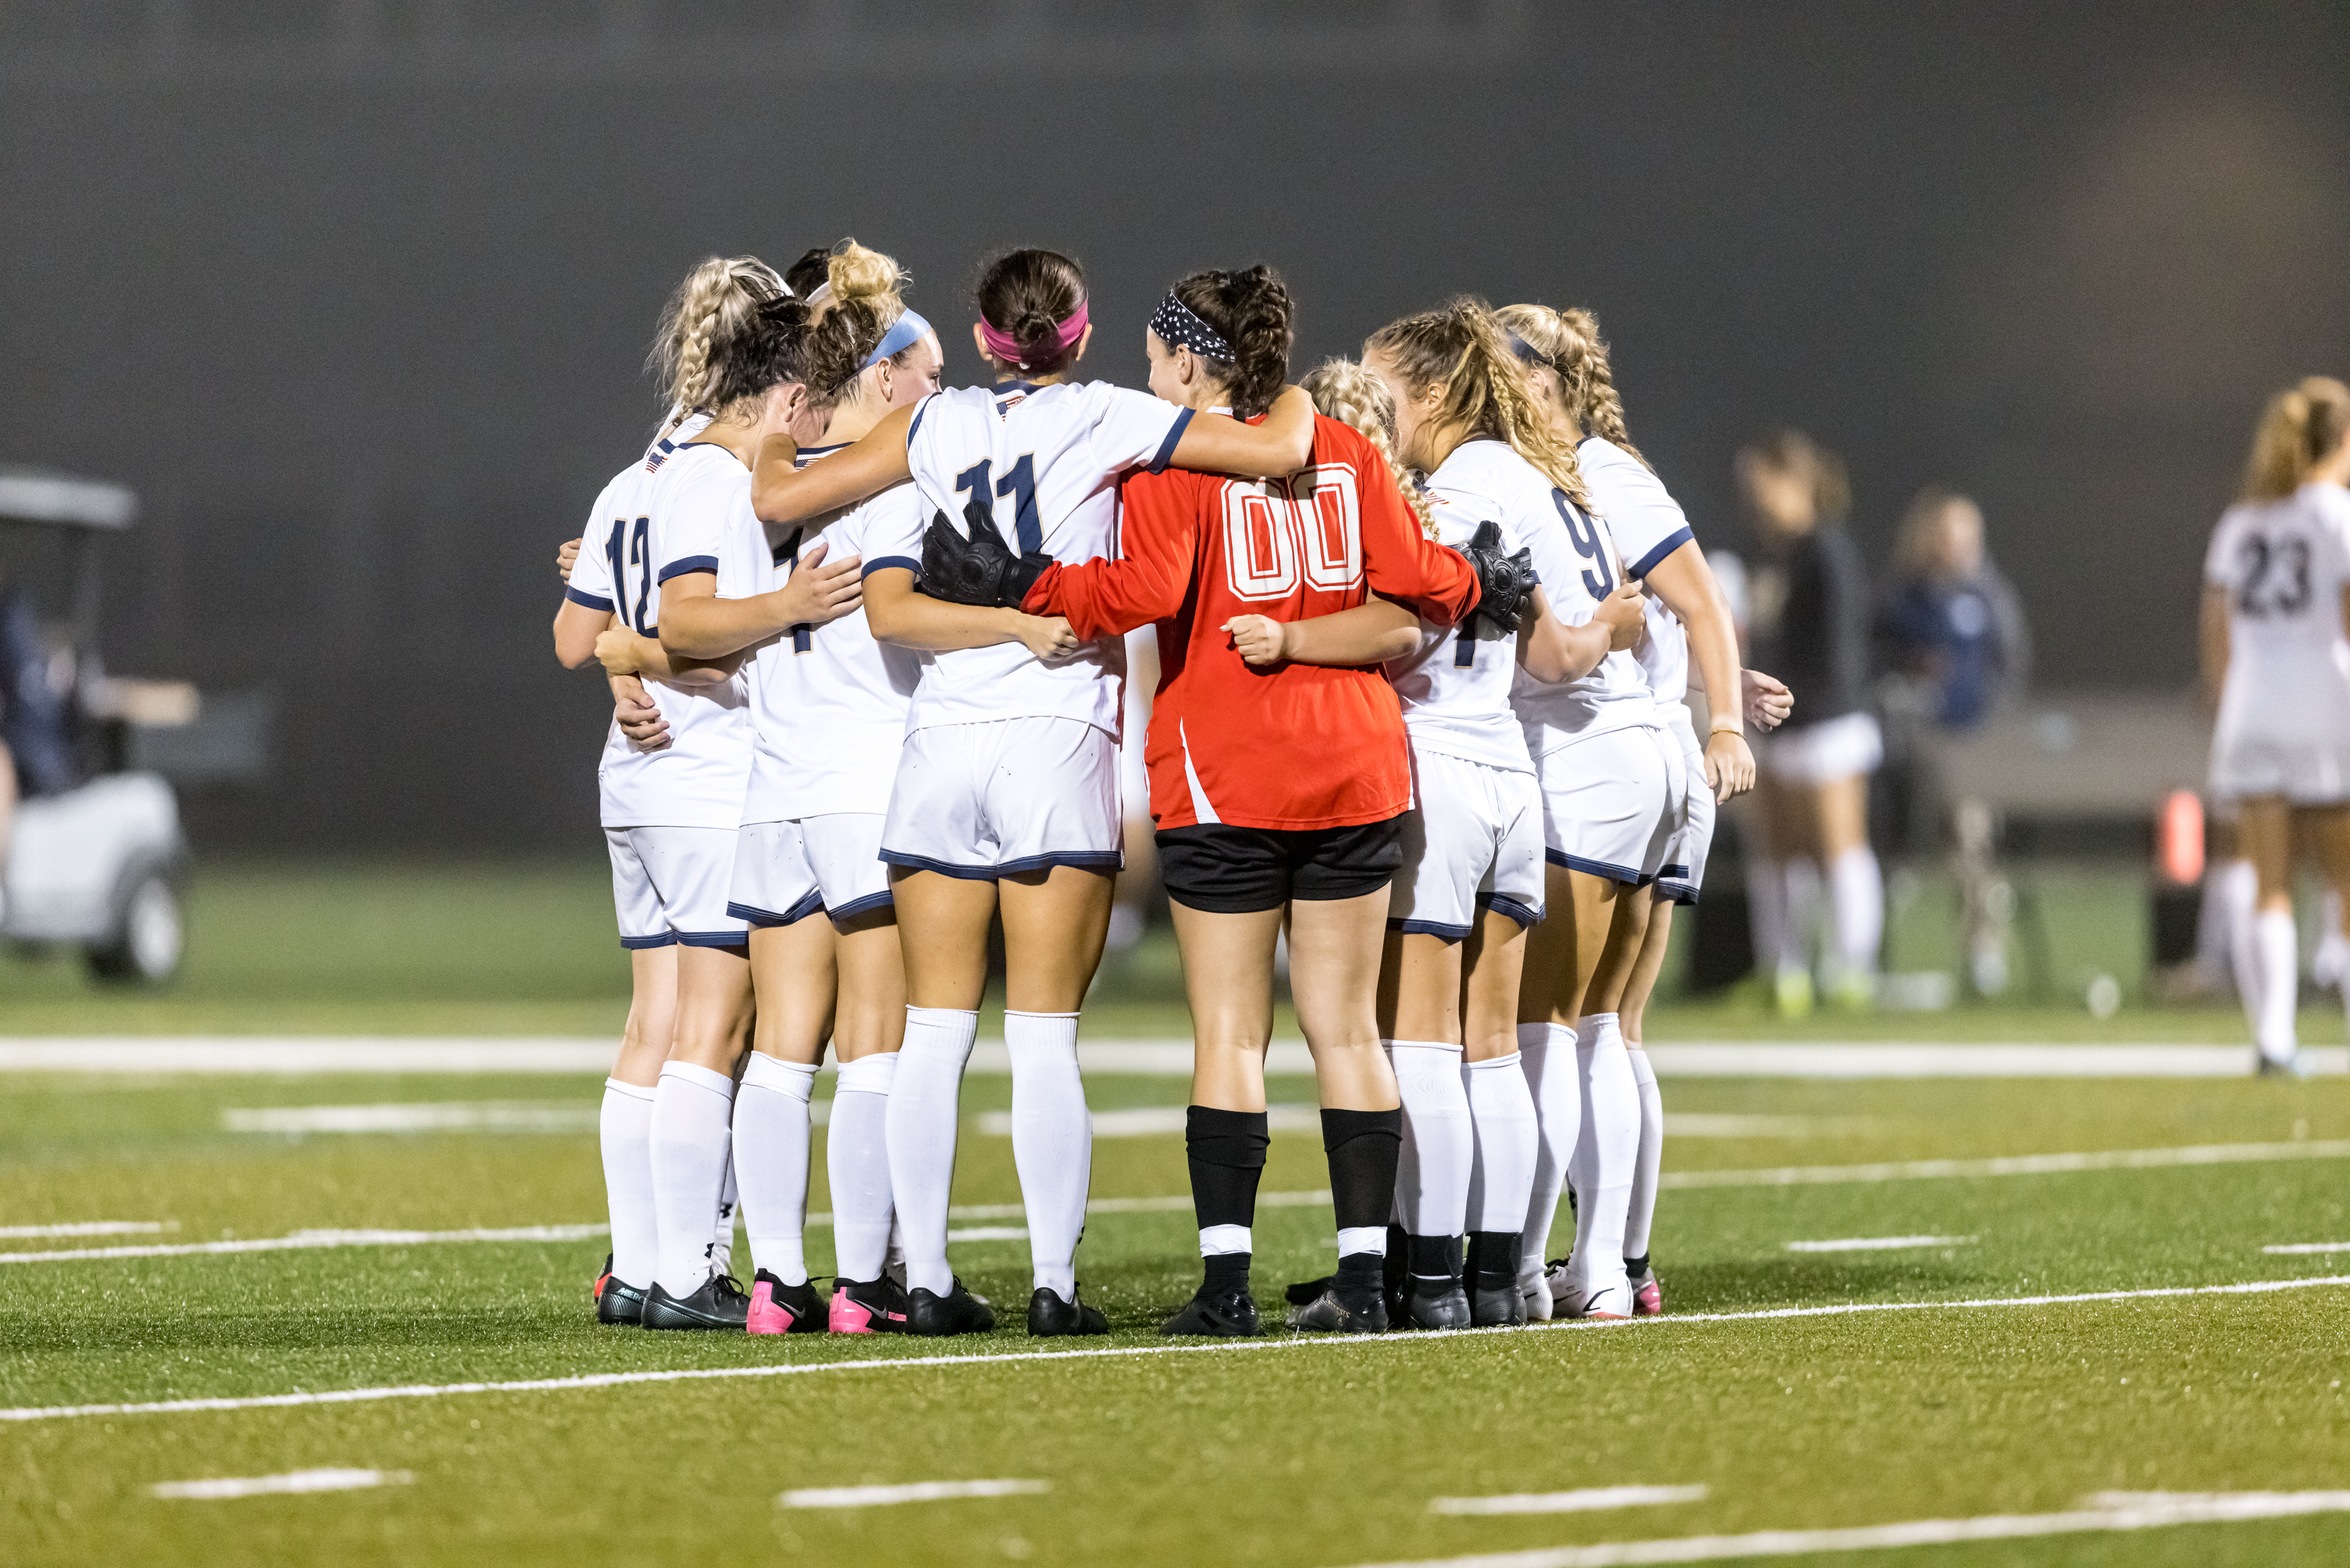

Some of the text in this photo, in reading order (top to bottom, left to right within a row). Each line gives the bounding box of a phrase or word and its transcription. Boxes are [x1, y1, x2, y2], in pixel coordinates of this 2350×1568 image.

[953, 451, 1045, 560] 11
[1220, 462, 1364, 602] 00
[1551, 486, 1614, 603] 9
[605, 514, 660, 639] 12
[2235, 531, 2312, 621] 23
